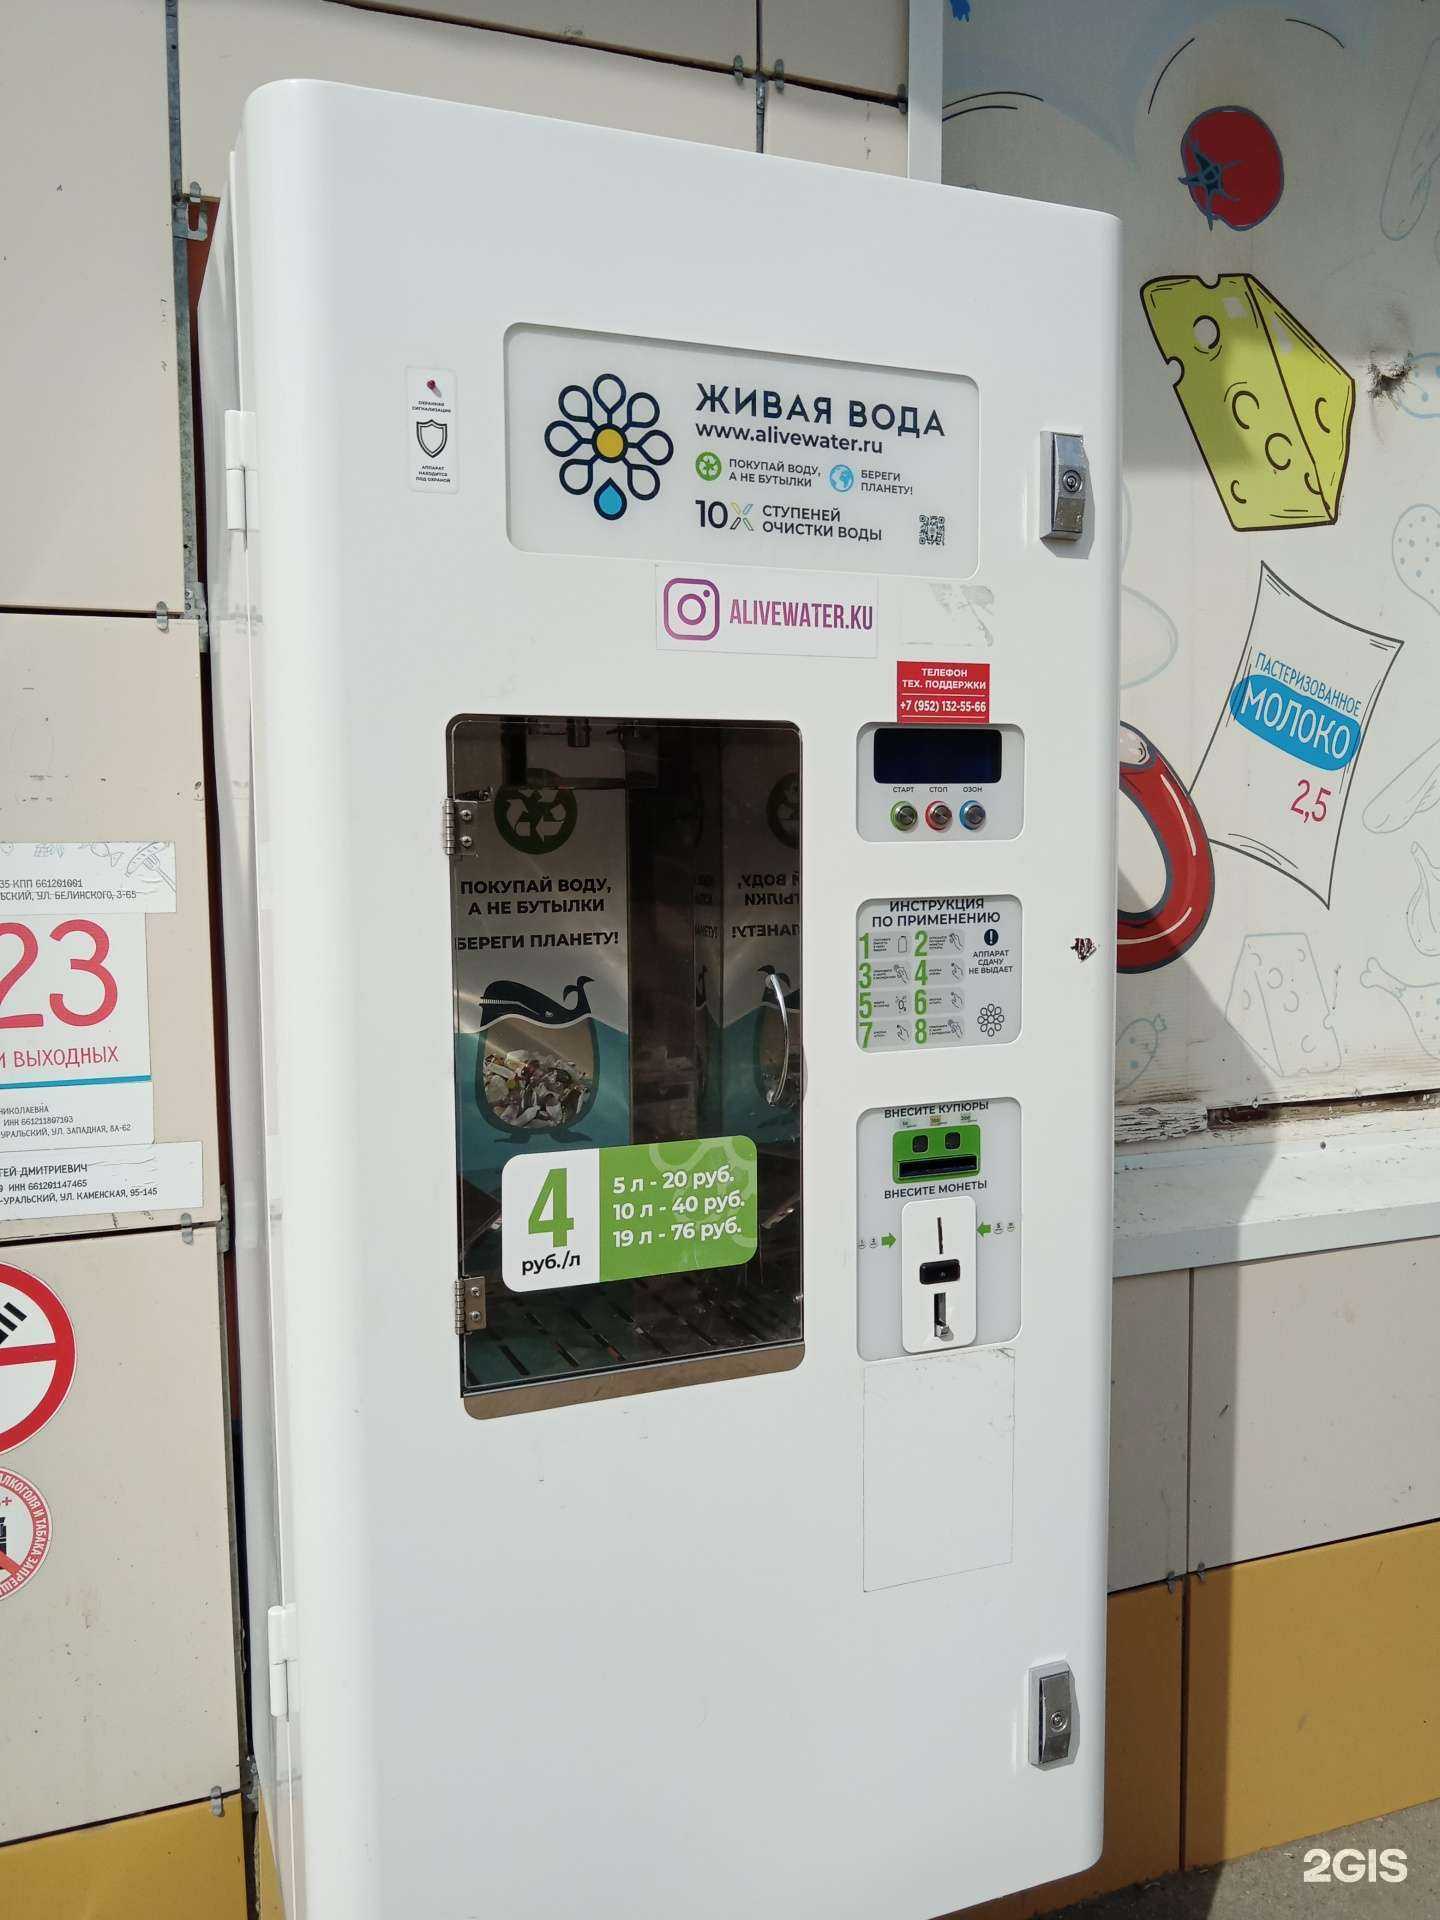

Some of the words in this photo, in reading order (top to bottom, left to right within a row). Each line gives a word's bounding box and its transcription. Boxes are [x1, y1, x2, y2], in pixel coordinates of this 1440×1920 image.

[695, 383, 832, 424] ЖИВАЯ
[849, 399, 945, 438] ВОДА
[695, 423, 883, 454] www.alivewater.ru
[728, 458, 785, 473] ПОКУПАЙ
[788, 464, 822, 478] ВОДУ,
[860, 469, 901, 482] БЕРЕГИ
[728, 472, 738, 481] А
[740, 473, 756, 483] НЕ
[758, 474, 813, 488] БУТЫЛКИ
[860, 482, 913, 495] ПЛАНЕТУ!
[762, 505, 841, 522] СТУПЕНЕЙ
[762, 521, 834, 538] ОЧИСТКИ
[838, 526, 883, 541] ВОДЫ
[729, 599, 873, 630] ALIVEWATER.KU
[921, 668, 968, 677] ТЕЛЕФОН
[902, 679, 923, 688] ТЕХ.
[925, 680, 986, 690] ПОДДЕРЖКИ
[1254, 652, 1362, 717] ПАСТЕРИЗОВАННОЕ
[900, 700, 912, 711] +7
[914, 700, 940, 712] (952)
[942, 700, 986, 712] 132-55-66
[1240, 682, 1351, 759] МОЛОКО
[1290, 779, 1332, 823] 2,5
[13, 880, 33, 888] КПП
[35, 879, 84, 888] 661201001
[460, 876, 553, 895] ПОКУПАЙ
[558, 878, 612, 893] ВОДУ,
[116, 890, 137, 900] 3-65
[468, 902, 482, 915] А
[487, 901, 511, 915] НЕ
[517, 899, 605, 914] БУТЫЛКИ
[890, 898, 984, 912] ИНСТРУКЦИЯ
[872, 916, 893, 928] ПО
[897, 912, 1000, 927] ПРИМЕНЕНИЮ
[455, 935, 525, 950] БЕРЕГИ
[530, 931, 619, 948] ПЛАНЕТУ!
[859, 932, 870, 959] 1
[914, 930, 928, 957] 2
[972, 949, 1010, 958] АППАРАТ
[977, 958, 1004, 967] СДАЧУ
[859, 962, 872, 989] 3
[914, 960, 928, 986] 4
[968, 967, 980, 975] НЕ
[981, 966, 1013, 974] ВЫДАЕТ
[858, 992, 873, 1019] 5
[914, 989, 927, 1015] 6
[859, 1022, 873, 1048] 7
[914, 1018, 928, 1044] 8
[14, 1046, 119, 1068] ВЫХОДНЫХ
[884, 1105, 936, 1118] ВНЕСИТЕ
[938, 1101, 989, 1114] КУПЮРЫ
[3, 1119, 20, 1127] ИНН
[20, 1164, 88, 1178] ДМИТРИЕВИЧ
[613, 1177, 626, 1194] 5
[630, 1177, 644, 1192] л
[662, 1171, 688, 1189] 20
[693, 1165, 734, 1190] руб.
[8, 1183, 26, 1192] ИНН
[28, 1180, 88, 1191] 661201147465
[76, 1189, 128, 1200] КАМЕНСКАЯ,
[130, 1187, 158, 1197] 95-145
[884, 1185, 936, 1199] ВНЕСИТЕ
[938, 1180, 987, 1194] МОНЕТЫ
[528, 1168, 575, 1248] 4
[613, 1203, 635, 1221] 10
[639, 1203, 653, 1218] л
[672, 1196, 698, 1214] 40
[704, 1189, 745, 1214] руб.
[613, 1230, 634, 1248] 19
[638, 1230, 652, 1245] л
[671, 1223, 696, 1241] 76
[701, 1216, 742, 1242] руб.
[521, 1250, 581, 1275] руб./л
[31, 1519, 48, 1556] ТАБАКА
